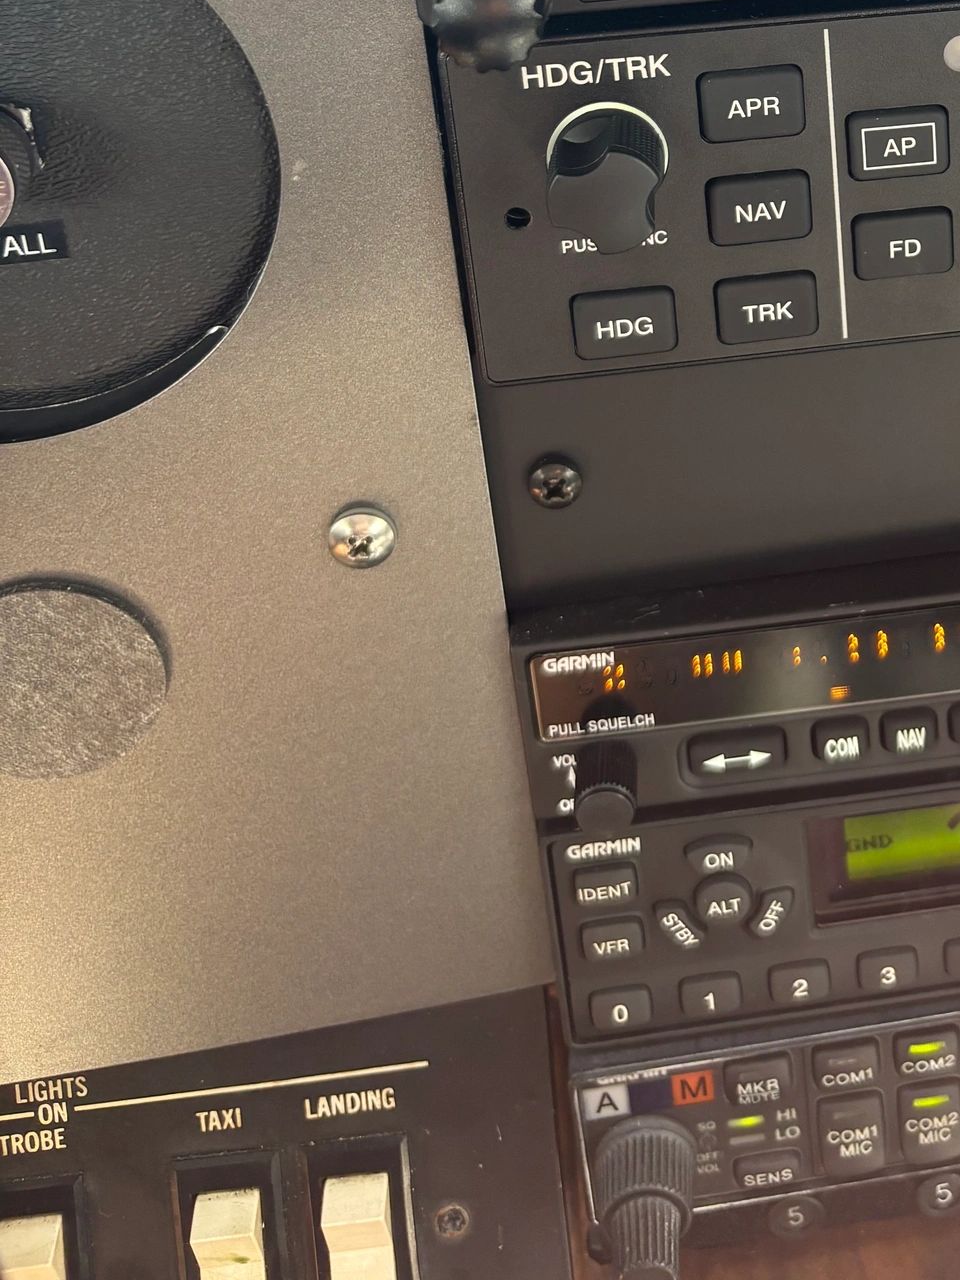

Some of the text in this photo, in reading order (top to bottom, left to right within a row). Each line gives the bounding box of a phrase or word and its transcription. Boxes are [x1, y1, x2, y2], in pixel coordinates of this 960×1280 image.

[520, 53, 672, 91] HDG/TRK
[727, 96, 781, 120] APR
[883, 137, 918, 159] AP
[735, 200, 788, 224] NAV
[888, 238, 923, 259] FD
[741, 300, 795, 324] TRK
[595, 316, 655, 340] HDG
[542, 651, 616, 673] GARMIN
[549, 712, 656, 739] PULL SQUELCH
[824, 735, 860, 759] COM
[896, 726, 927, 750] NAV
[566, 837, 642, 860] GARMIN
[703, 851, 735, 869] ON
[576, 881, 632, 903] IDENT
[706, 897, 742, 917] ALT
[661, 911, 700, 948] STBY
[593, 937, 631, 956] VFR
[901, 1054, 956, 1074] COM2
[736, 1078, 780, 1097] MKR
[821, 1067, 874, 1087] COM1
[14, 1075, 89, 1105] LIGHTS
[37, 1102, 70, 1126] ON
[303, 1087, 397, 1121] LANDING
[775, 1107, 798, 1122] HI
[195, 1106, 243, 1133] TAXI
[904, 1111, 960, 1132] COM2
[0, 1127, 67, 1158] TROBE
[774, 1125, 801, 1141] LO
[826, 1124, 879, 1144] COM1
[918, 1127, 952, 1145] MIC
[839, 1140, 873, 1158] MIC
[743, 1168, 794, 1187] SENS
